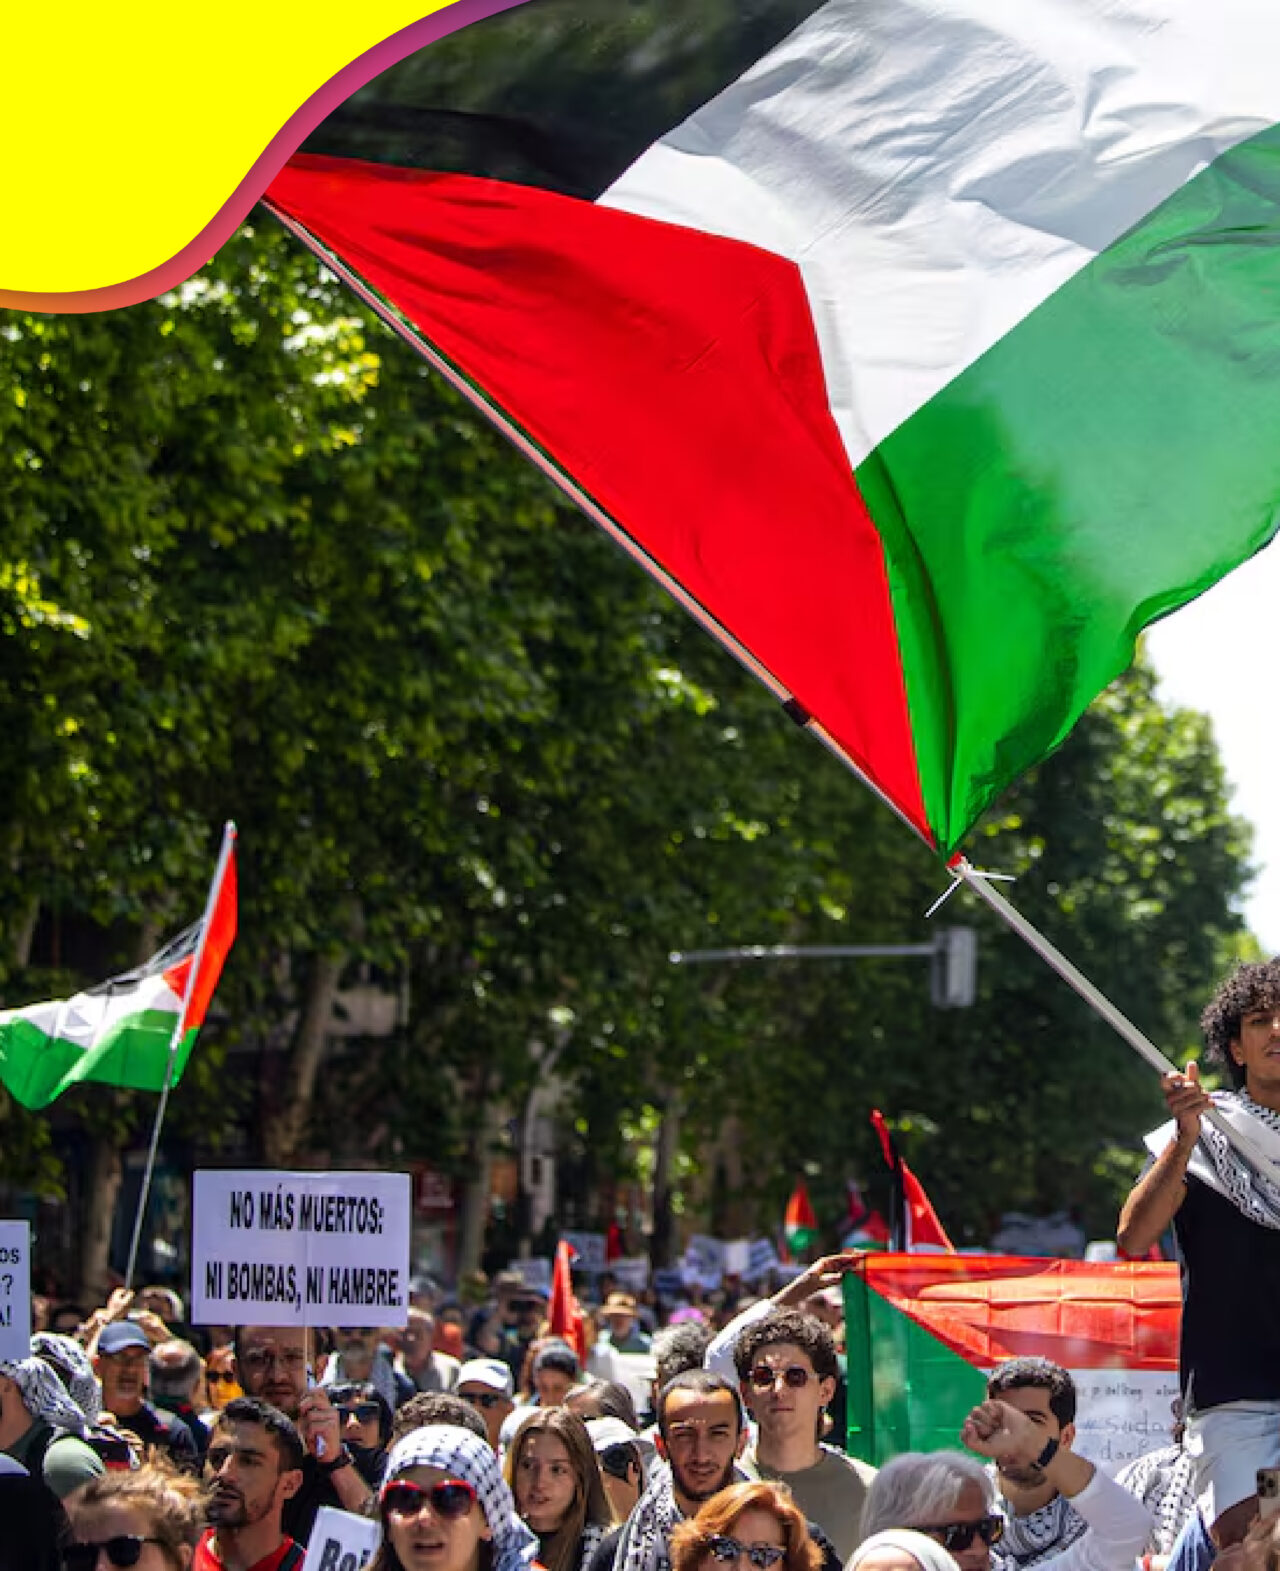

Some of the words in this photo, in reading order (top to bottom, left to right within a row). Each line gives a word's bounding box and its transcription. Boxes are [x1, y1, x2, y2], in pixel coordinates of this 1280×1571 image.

[230, 1191, 254, 1230] NO
[259, 1182, 294, 1230] MÁS
[298, 1193, 384, 1234] MUERTOS:
[205, 1261, 223, 1300] NI
[227, 1261, 301, 1312] BOMBAS,
[306, 1266, 324, 1304] NI
[328, 1266, 403, 1306] HAMBRE.
